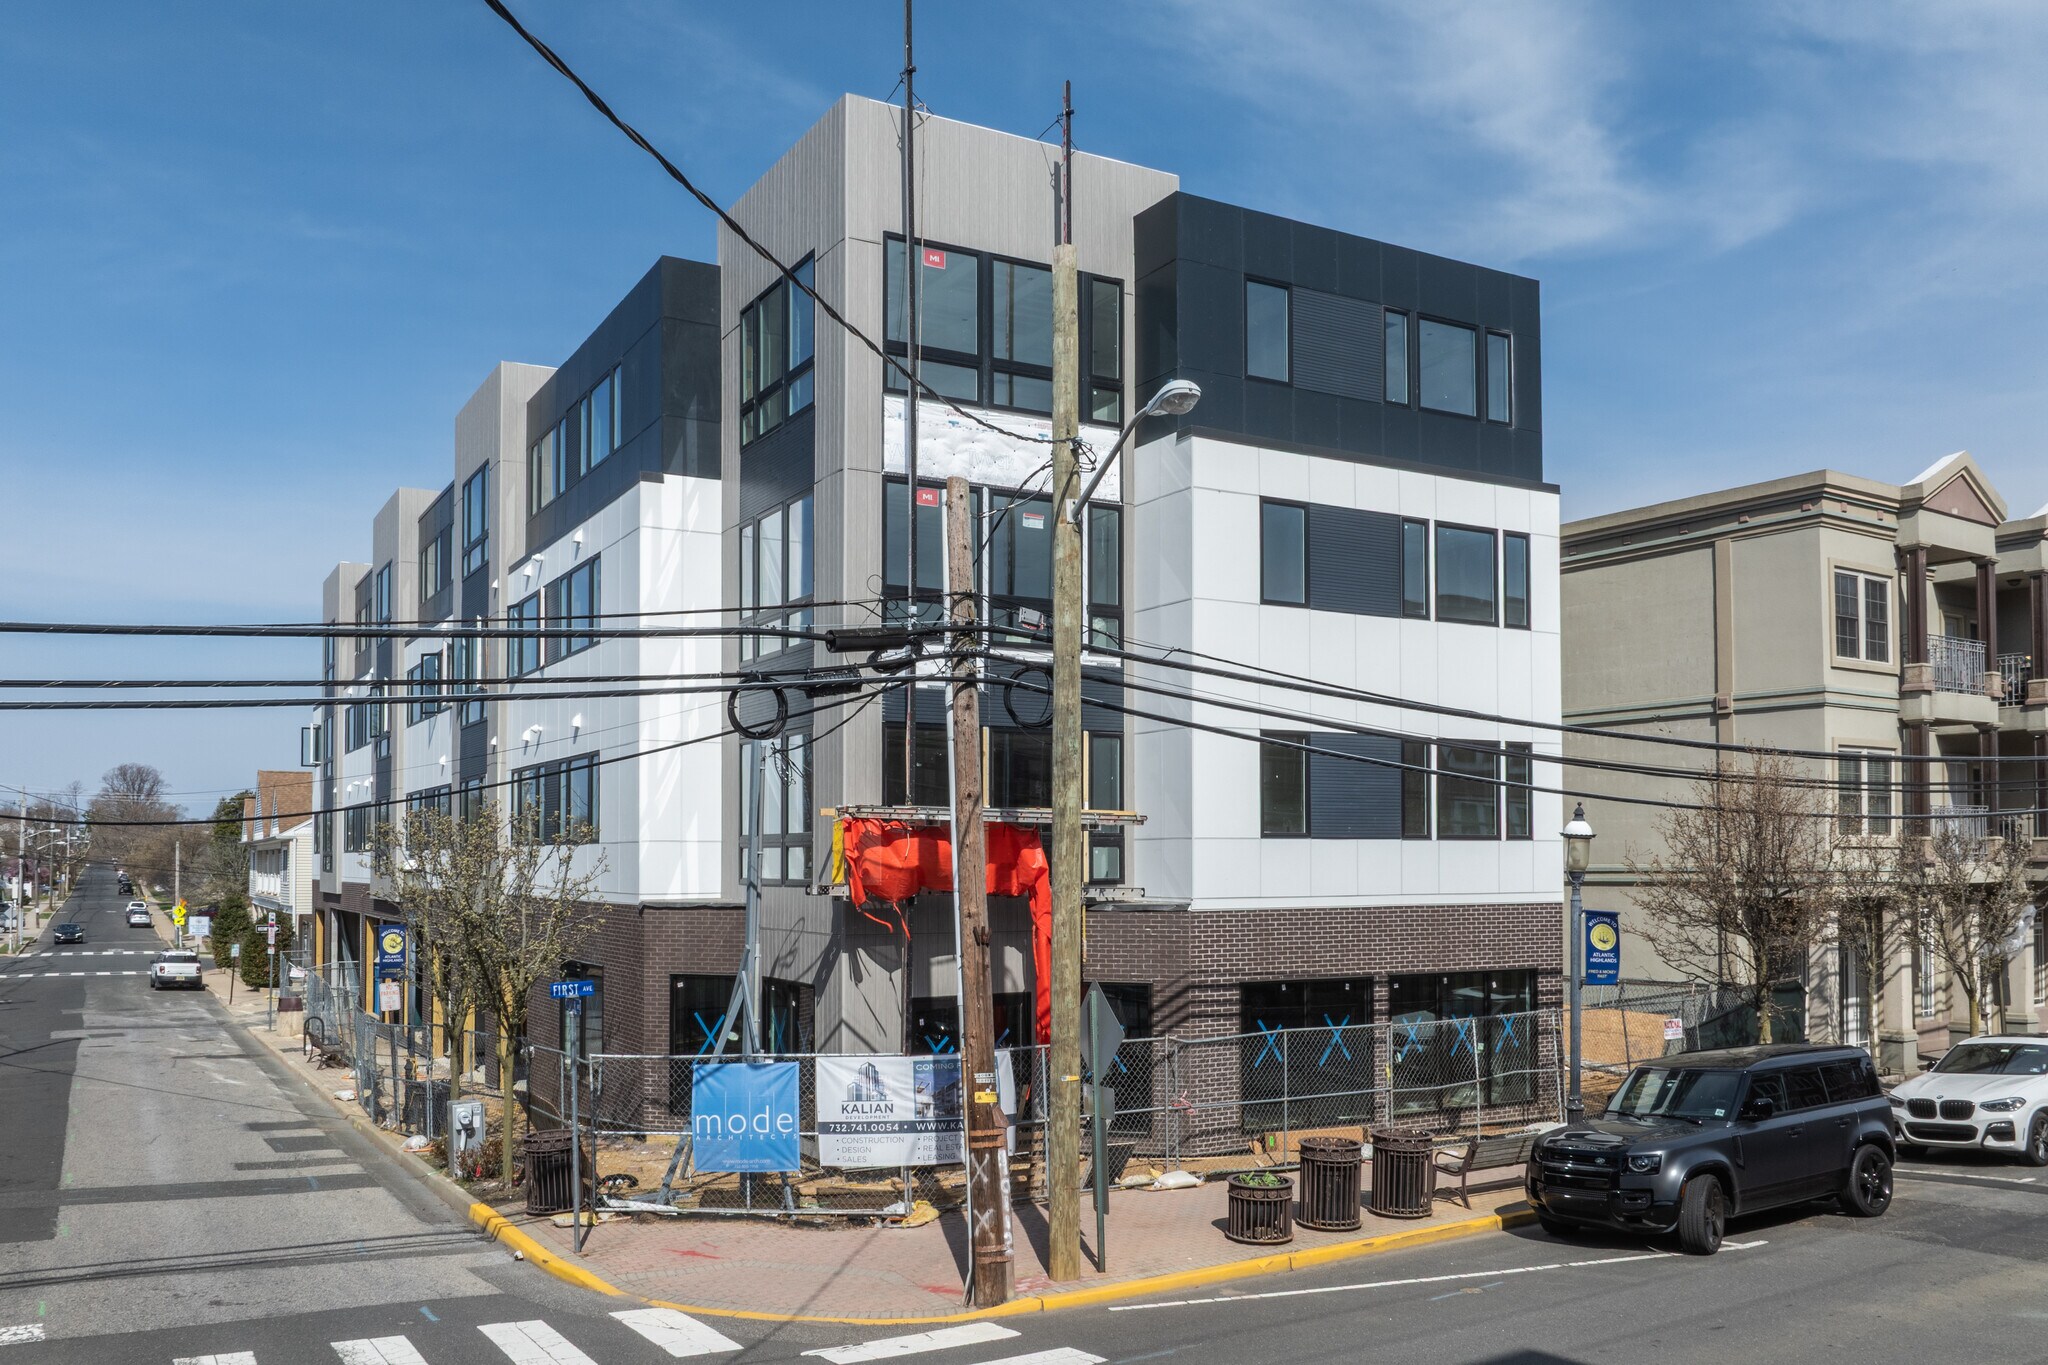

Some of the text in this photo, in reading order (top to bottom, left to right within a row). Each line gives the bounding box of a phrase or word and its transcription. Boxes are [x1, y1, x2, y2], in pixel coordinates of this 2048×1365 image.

[929, 254, 940, 263] MI
[922, 493, 933, 501] MI
[1588, 917, 1611, 927] WELCOME
[381, 929, 399, 937] WELCOME
[553, 983, 578, 996] FIRST
[915, 1063, 955, 1071] COMING
[841, 1103, 894, 1115] KALIAN
[696, 1105, 793, 1134] mode
[829, 1123, 899, 1132] 732.741.0054
[841, 1136, 905, 1144] CONSTRUCTION
[923, 1134, 958, 1142] PROJECT
[842, 1146, 872, 1154] DESIGN
[923, 1144, 943, 1152] REAL
[842, 1155, 867, 1163] SALES
[923, 1152, 956, 1161] LEASING
